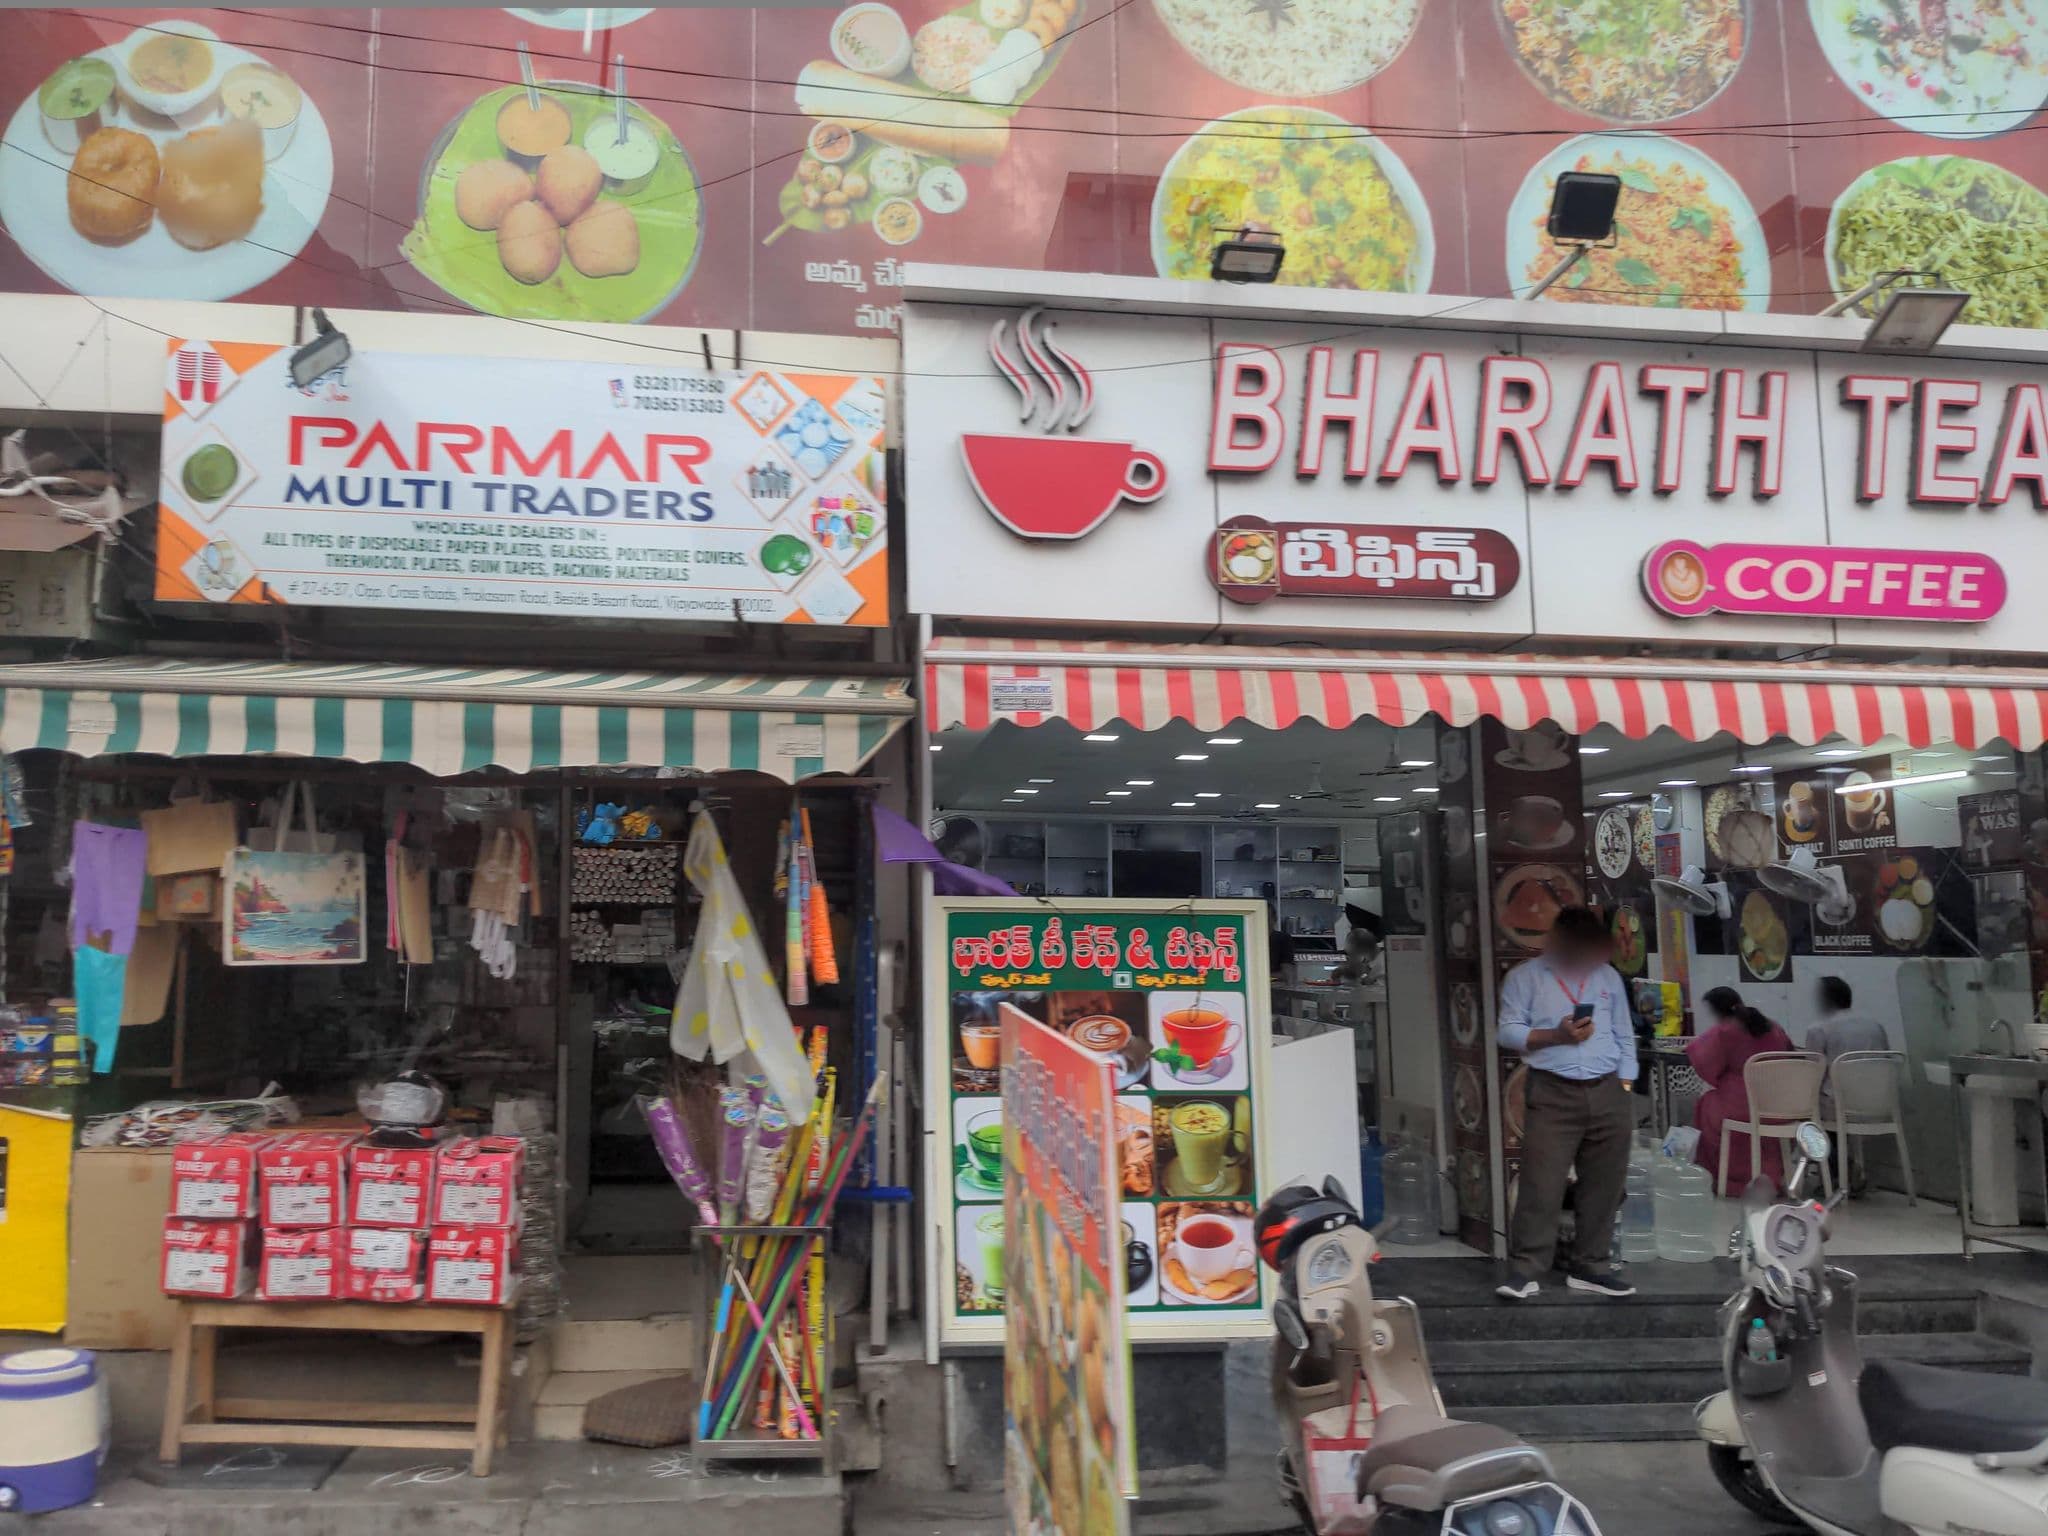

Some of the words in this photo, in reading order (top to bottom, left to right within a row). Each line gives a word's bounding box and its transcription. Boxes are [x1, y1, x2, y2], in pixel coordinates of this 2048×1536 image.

[805, 259, 867, 293] అమ్మ
[1208, 342, 1788, 498] BHARATH
[1841, 373, 2048, 507] TEA
[288, 416, 713, 484] PARMAR
[284, 474, 452, 510] MULTI
[473, 482, 716, 522] TRADERS
[262, 532, 288, 547] ALL
[292, 533, 335, 548] TYPES
[338, 535, 355, 549] OF
[359, 536, 443, 553] DISPOSABLE
[448, 540, 489, 555] PAPER
[616, 547, 690, 564] POLYTHENE
[413, 521, 505, 537] WHOLESALE
[508, 524, 575, 541] DEALERS
[579, 527, 597, 541] IN
[326, 553, 406, 570] THERMOCOL
[469, 559, 500, 574] GUM
[553, 563, 611, 579] PACKING
[616, 565, 690, 581] MATERIALS
[1282, 529, 1495, 596] టిఫిన్స్
[554, 591, 589, 606] Beside
[1725, 557, 1986, 610] COFFEE
[1838, 839, 1863, 852] SONTI
[1864, 836, 1896, 849] COFFEE
[953, 925, 1034, 977] భారత్
[1040, 917, 1067, 969] టీ
[1125, 927, 1159, 970] &
[1815, 935, 1839, 947] BLACK
[1840, 934, 1872, 947] COFFEE
